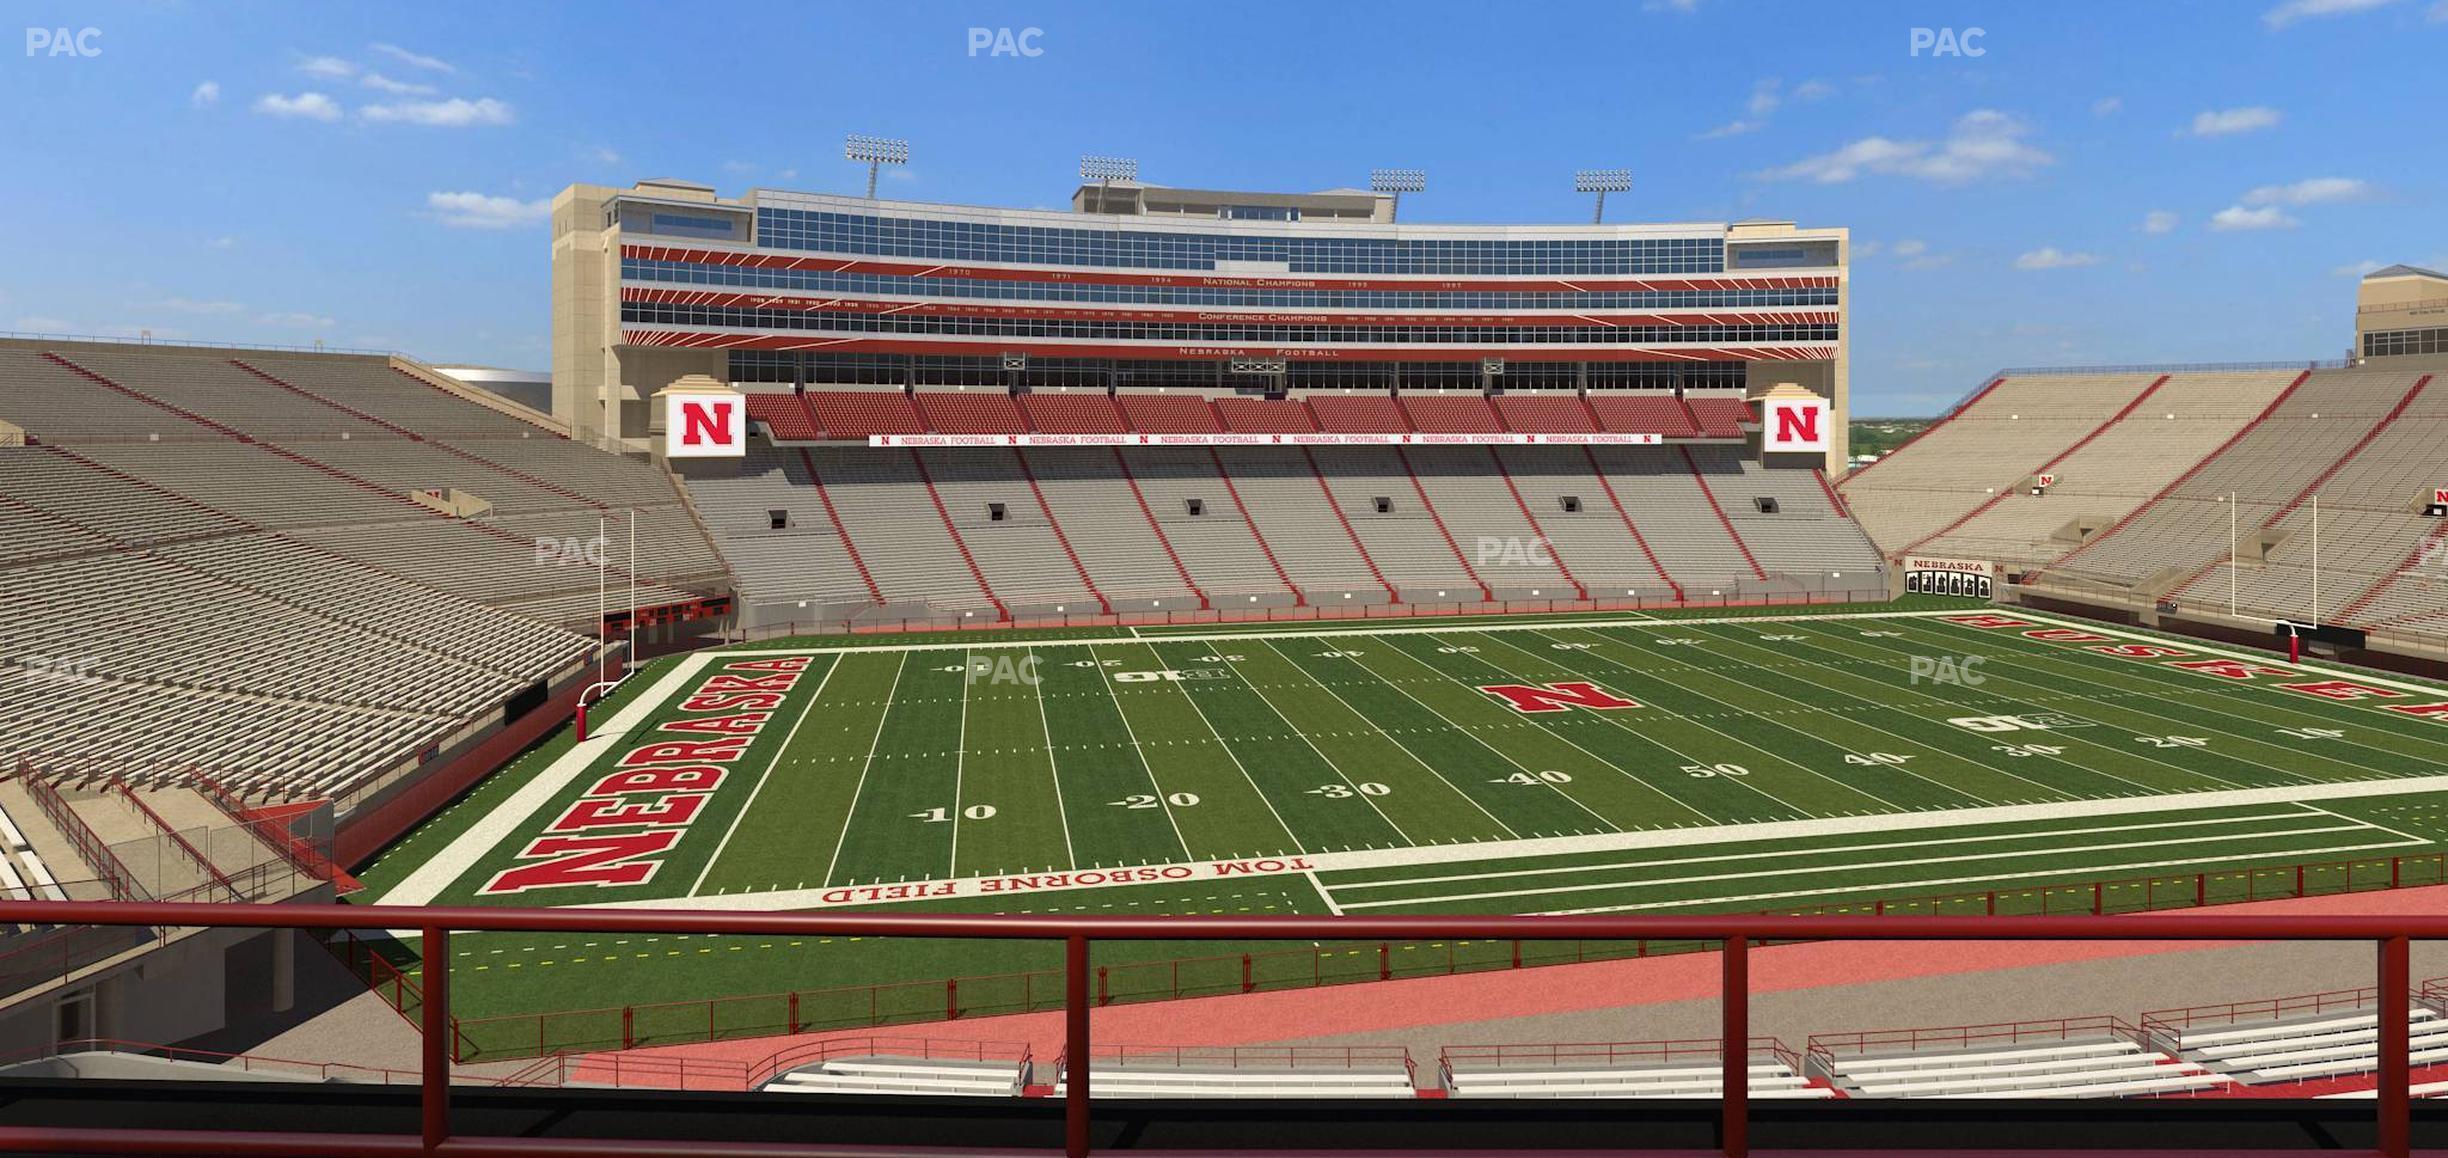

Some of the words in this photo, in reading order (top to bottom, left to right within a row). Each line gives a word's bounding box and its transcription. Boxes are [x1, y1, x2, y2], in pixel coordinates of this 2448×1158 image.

[1203, 277, 1250, 286] NATIONAL
[1257, 278, 1316, 287] CHAMPIONS
[1198, 313, 1265, 321] CONFERENCE
[1268, 313, 1327, 322] CHAMPIONS
[1179, 347, 1245, 355] NEBRASKA
[1276, 348, 1339, 357] FOOTBALL
[682, 402, 732, 445] N
[1776, 406, 1819, 442] N
[881, 436, 890, 445] N
[901, 437, 948, 445] NEBRASKA
[951, 437, 996, 445] FOOTBALL
[1008, 436, 1017, 445] N
[1029, 436, 1076, 445] NEBRASKA
[1080, 436, 1127, 444] FOOTBALL
[1139, 436, 1148, 444] N
[1161, 436, 1208, 444] NEBRASKA
[1213, 436, 1259, 444] FOOTBALL
[1272, 435, 1281, 443] N
[1293, 435, 1341, 444] NEBRASKA
[1344, 435, 1390, 443] FOOTBALL
[1403, 435, 1411, 443] N
[1423, 435, 1468, 443] NEBRASKA
[1472, 435, 1515, 443] FOOTBALL
[1527, 434, 1535, 443] N
[1546, 435, 1589, 443] NEBRASKA
[1592, 435, 1633, 443] FOOTBALL
[1643, 434, 1652, 443] N
[2436, 491, 2448, 502] N
[1914, 560, 1984, 571] NEBRASKA
[1476, 680, 1646, 714] N
[1991, 743, 2062, 757] 30
[1845, 751, 1908, 767] 40
[474, 655, 815, 896] NEBRASKA
[1505, 770, 1573, 787] 40
[1679, 763, 1750, 779] 50
[1319, 782, 1391, 799] 30
[1125, 792, 1200, 810] 20
[923, 804, 997, 823] 10
[1214, 858, 1314, 877] TOM
[980, 866, 1193, 892] OSBORNE
[821, 882, 955, 904] FIELD
